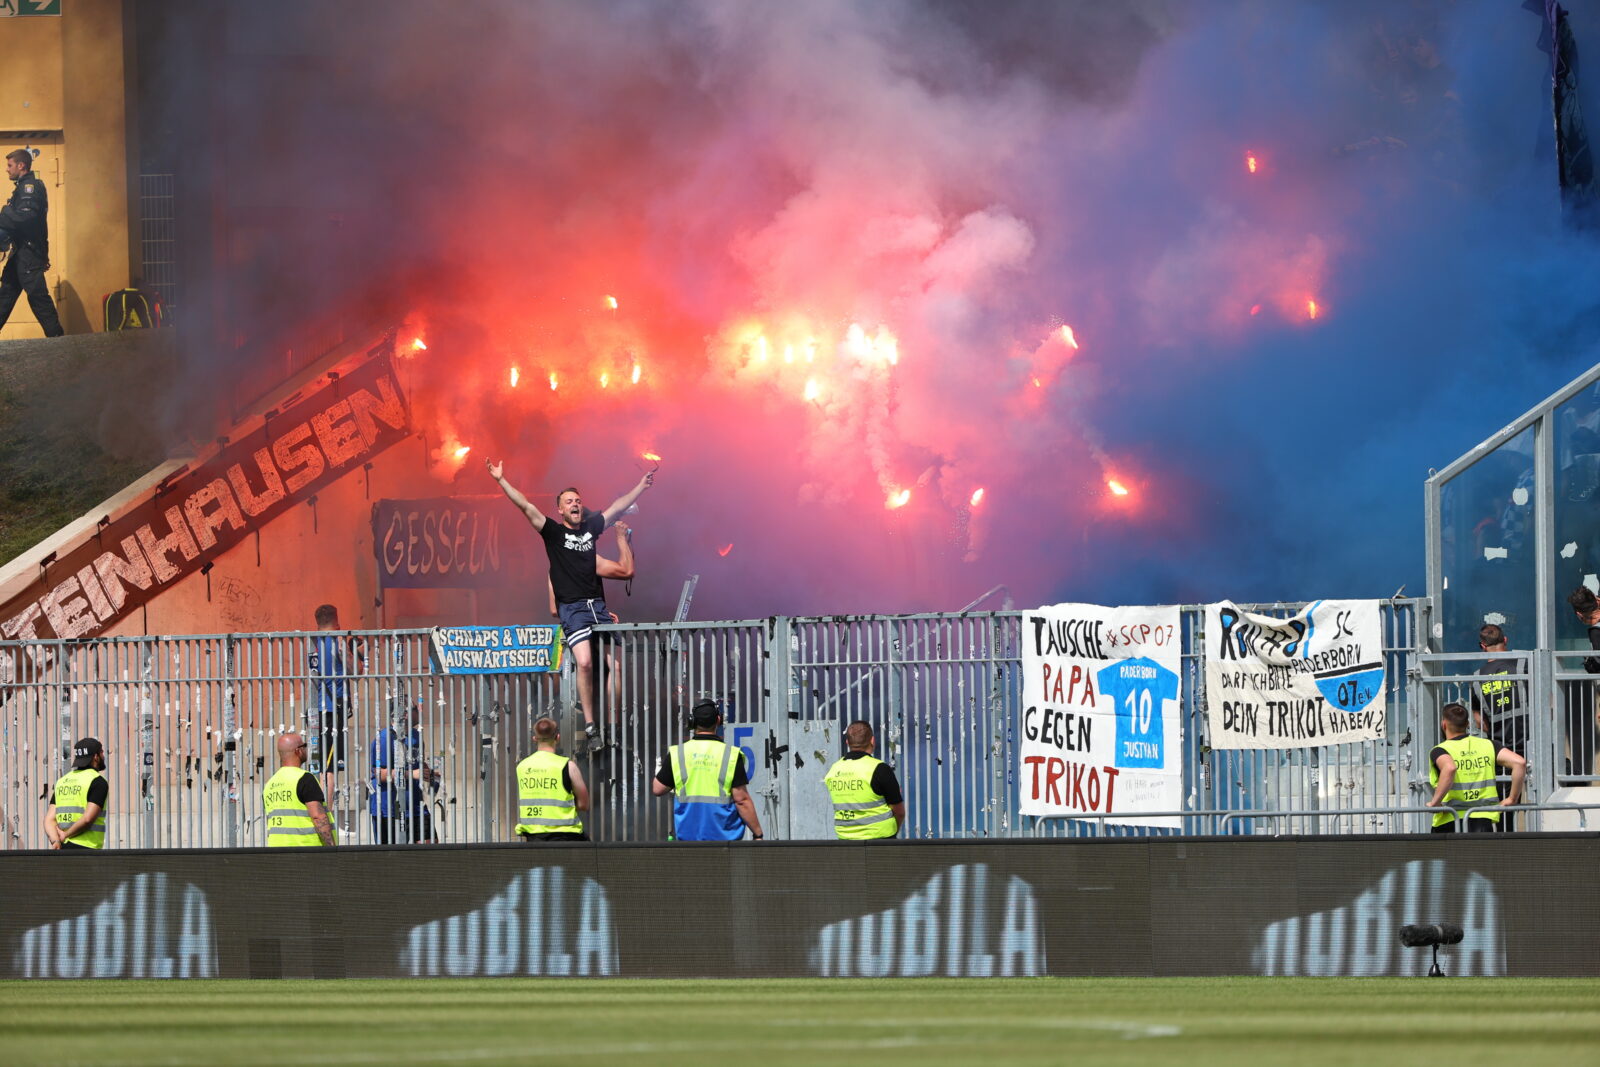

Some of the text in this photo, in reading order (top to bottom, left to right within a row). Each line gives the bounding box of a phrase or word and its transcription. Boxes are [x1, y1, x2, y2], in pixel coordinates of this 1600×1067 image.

[0, 373, 407, 685] TEINHAUSEN
[383, 510, 500, 575] GESSELN
[440, 627, 553, 647] SCHNAPS & WEED
[1030, 616, 1109, 660] TAUSCHE
[1333, 610, 1353, 639] SC
[445, 649, 552, 669] AUSWÄRTSSIEG!
[1120, 666, 1157, 679] PADERBORN
[1292, 642, 1361, 674] PADERBORN
[1043, 663, 1096, 708] PAPA
[1222, 671, 1248, 689] DARF
[1338, 680, 1358, 706] 07
[1125, 688, 1152, 735] 10
[1223, 701, 1259, 737] DEIN
[1266, 697, 1325, 739] TRIKOT
[1025, 706, 1092, 753] GEGEN
[57, 785, 82, 796] RDNER
[1024, 756, 1120, 814] TRIKOT
[1464, 790, 1480, 800] 129
[272, 817, 282, 826] 13
